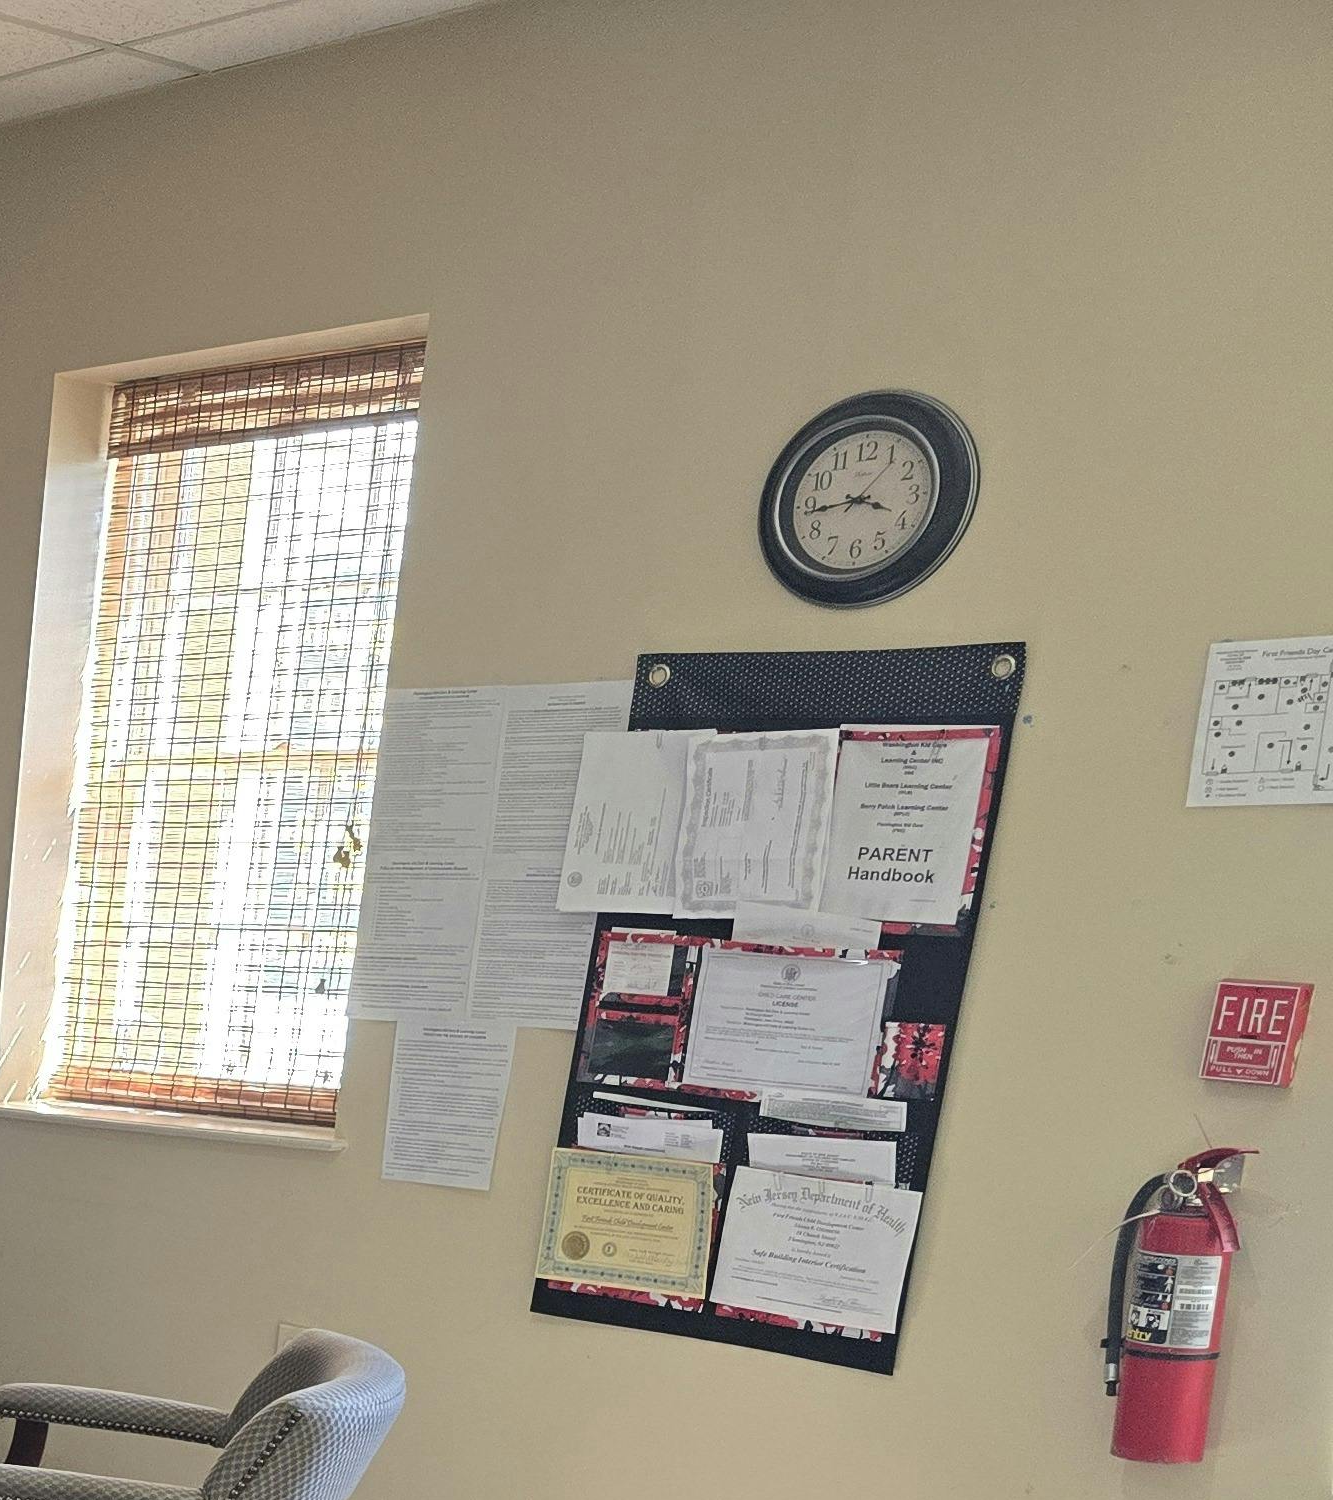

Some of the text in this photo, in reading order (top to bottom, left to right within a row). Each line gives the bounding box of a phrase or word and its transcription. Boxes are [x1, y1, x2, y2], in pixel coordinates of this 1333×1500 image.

[832, 450, 848, 471] 11
[856, 441, 878, 462] 12
[887, 444, 895, 464] 1
[813, 470, 832, 491] 10
[900, 460, 914, 481] 2
[906, 484, 920, 504] 3
[804, 496, 817, 514] 9
[809, 520, 821, 540] 8
[895, 510, 907, 530] 4
[827, 536, 839, 556] 7
[849, 539, 862, 559] 6
[874, 531, 887, 551] 5
[896, 804, 925, 812] Learning
[857, 846, 933, 863] PARENT
[847, 866, 935, 884] Handbook
[1217, 996, 1289, 1035] FIRE
[1210, 1065, 1232, 1073] PULL
[576, 1196, 685, 1215] EXCELLENCE AND CARING
[577, 1186, 685, 1205] CERTIFICATE OF QUALITY,
[735, 1193, 762, 1211] New
[763, 1188, 798, 1202] Jersey
[800, 1187, 862, 1211] Department
[861, 1203, 873, 1213] of
[874, 1205, 906, 1237] Health
[752, 1249, 767, 1257] Safe
[768, 1251, 797, 1263] Building
[825, 1261, 866, 1274] Certification
